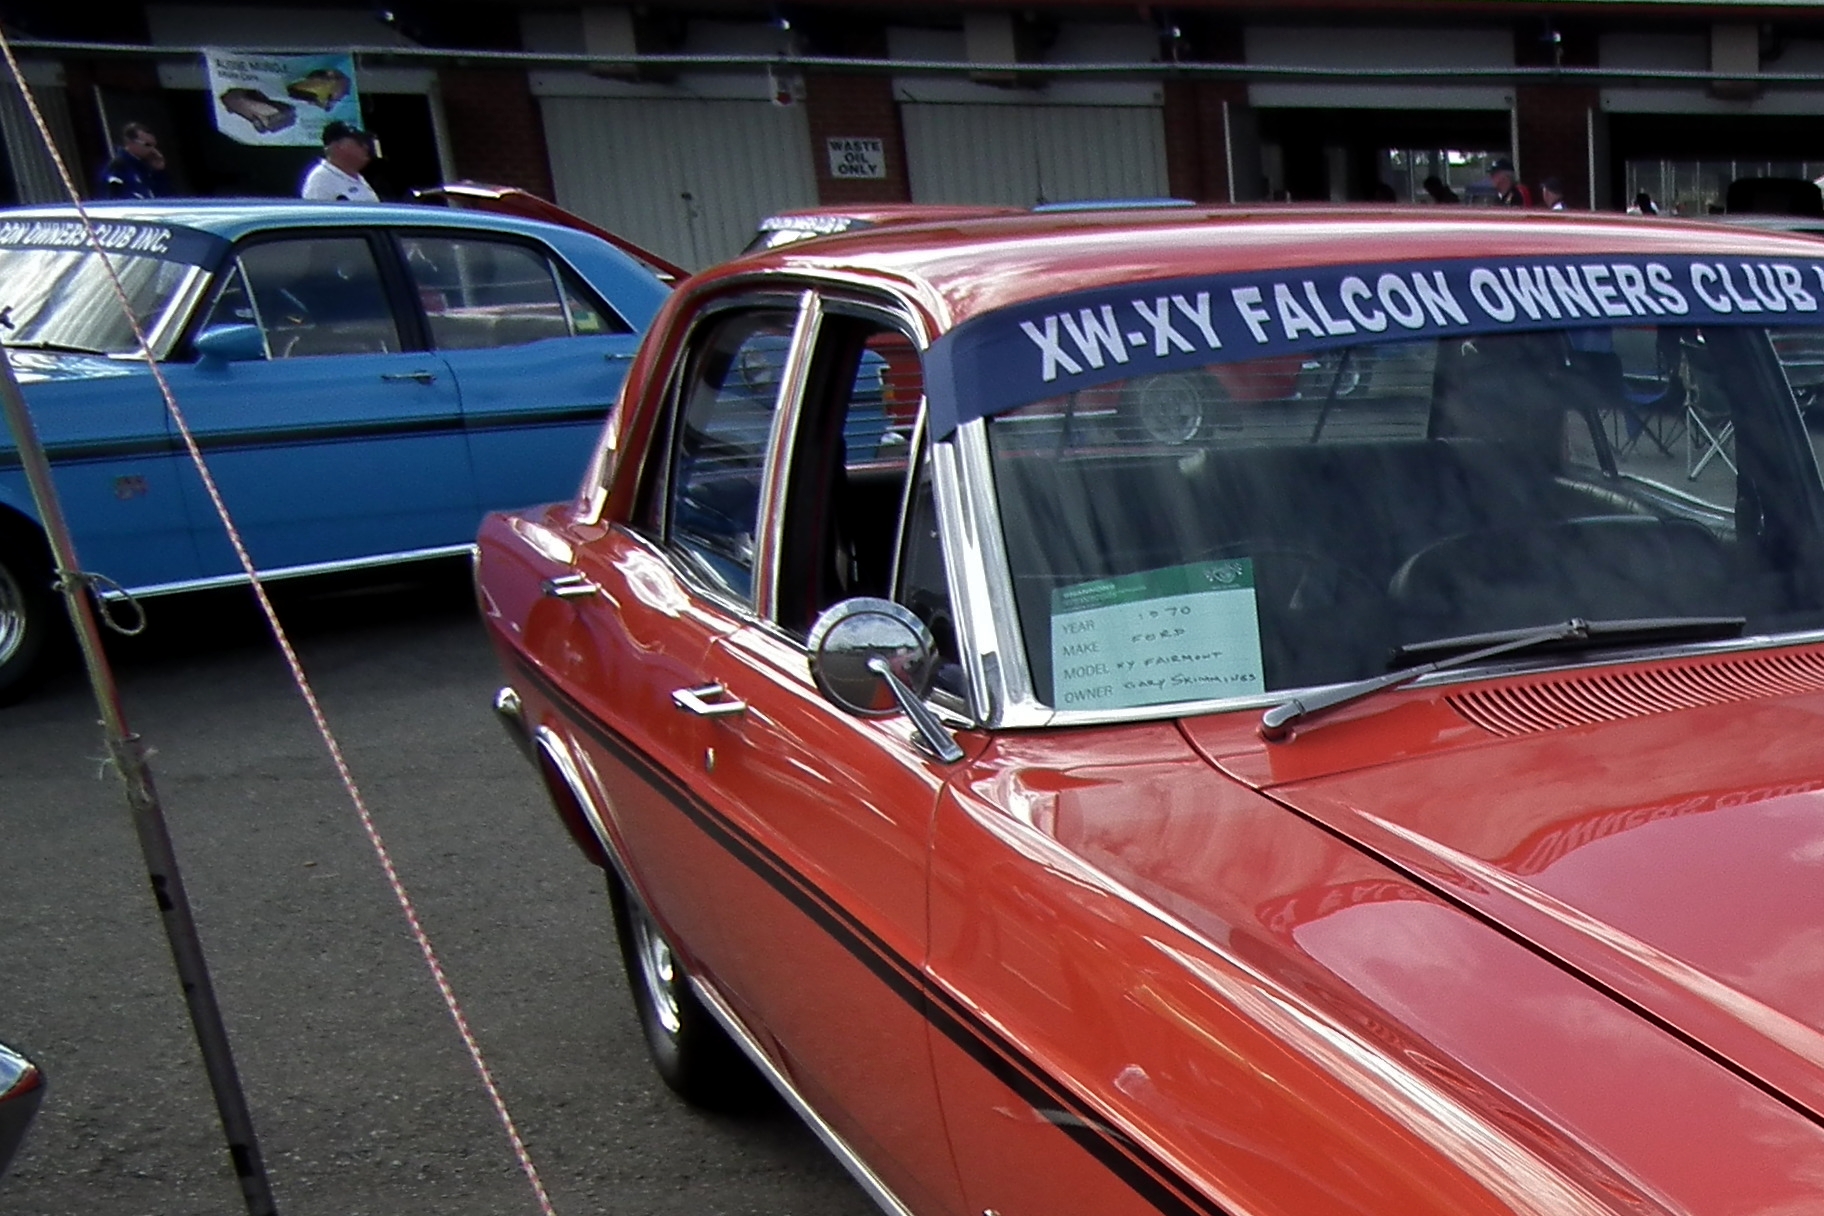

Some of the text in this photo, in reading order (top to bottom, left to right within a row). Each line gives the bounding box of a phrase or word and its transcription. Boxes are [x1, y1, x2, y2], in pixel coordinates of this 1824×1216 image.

[829, 140, 881, 152] WASTE
[844, 152, 869, 164] OIL
[837, 163, 878, 175] ONLY
[22, 221, 88, 246] OWNERS
[86, 223, 137, 249] CLUB
[130, 226, 172, 254] INC.
[1019, 291, 1223, 383] XW-XY
[1230, 270, 1470, 344] FALCON
[1469, 262, 1690, 323] OWNERS
[1690, 261, 1818, 314] CLUB
[1138, 605, 1192, 620] 1970
[1062, 619, 1096, 635] YEAR
[1131, 628, 1186, 643] FORD
[1062, 641, 1101, 657] MAKE
[1144, 651, 1223, 667] FAIRMONT
[1064, 663, 1111, 681] MODEL
[1064, 684, 1114, 704] OWNER
